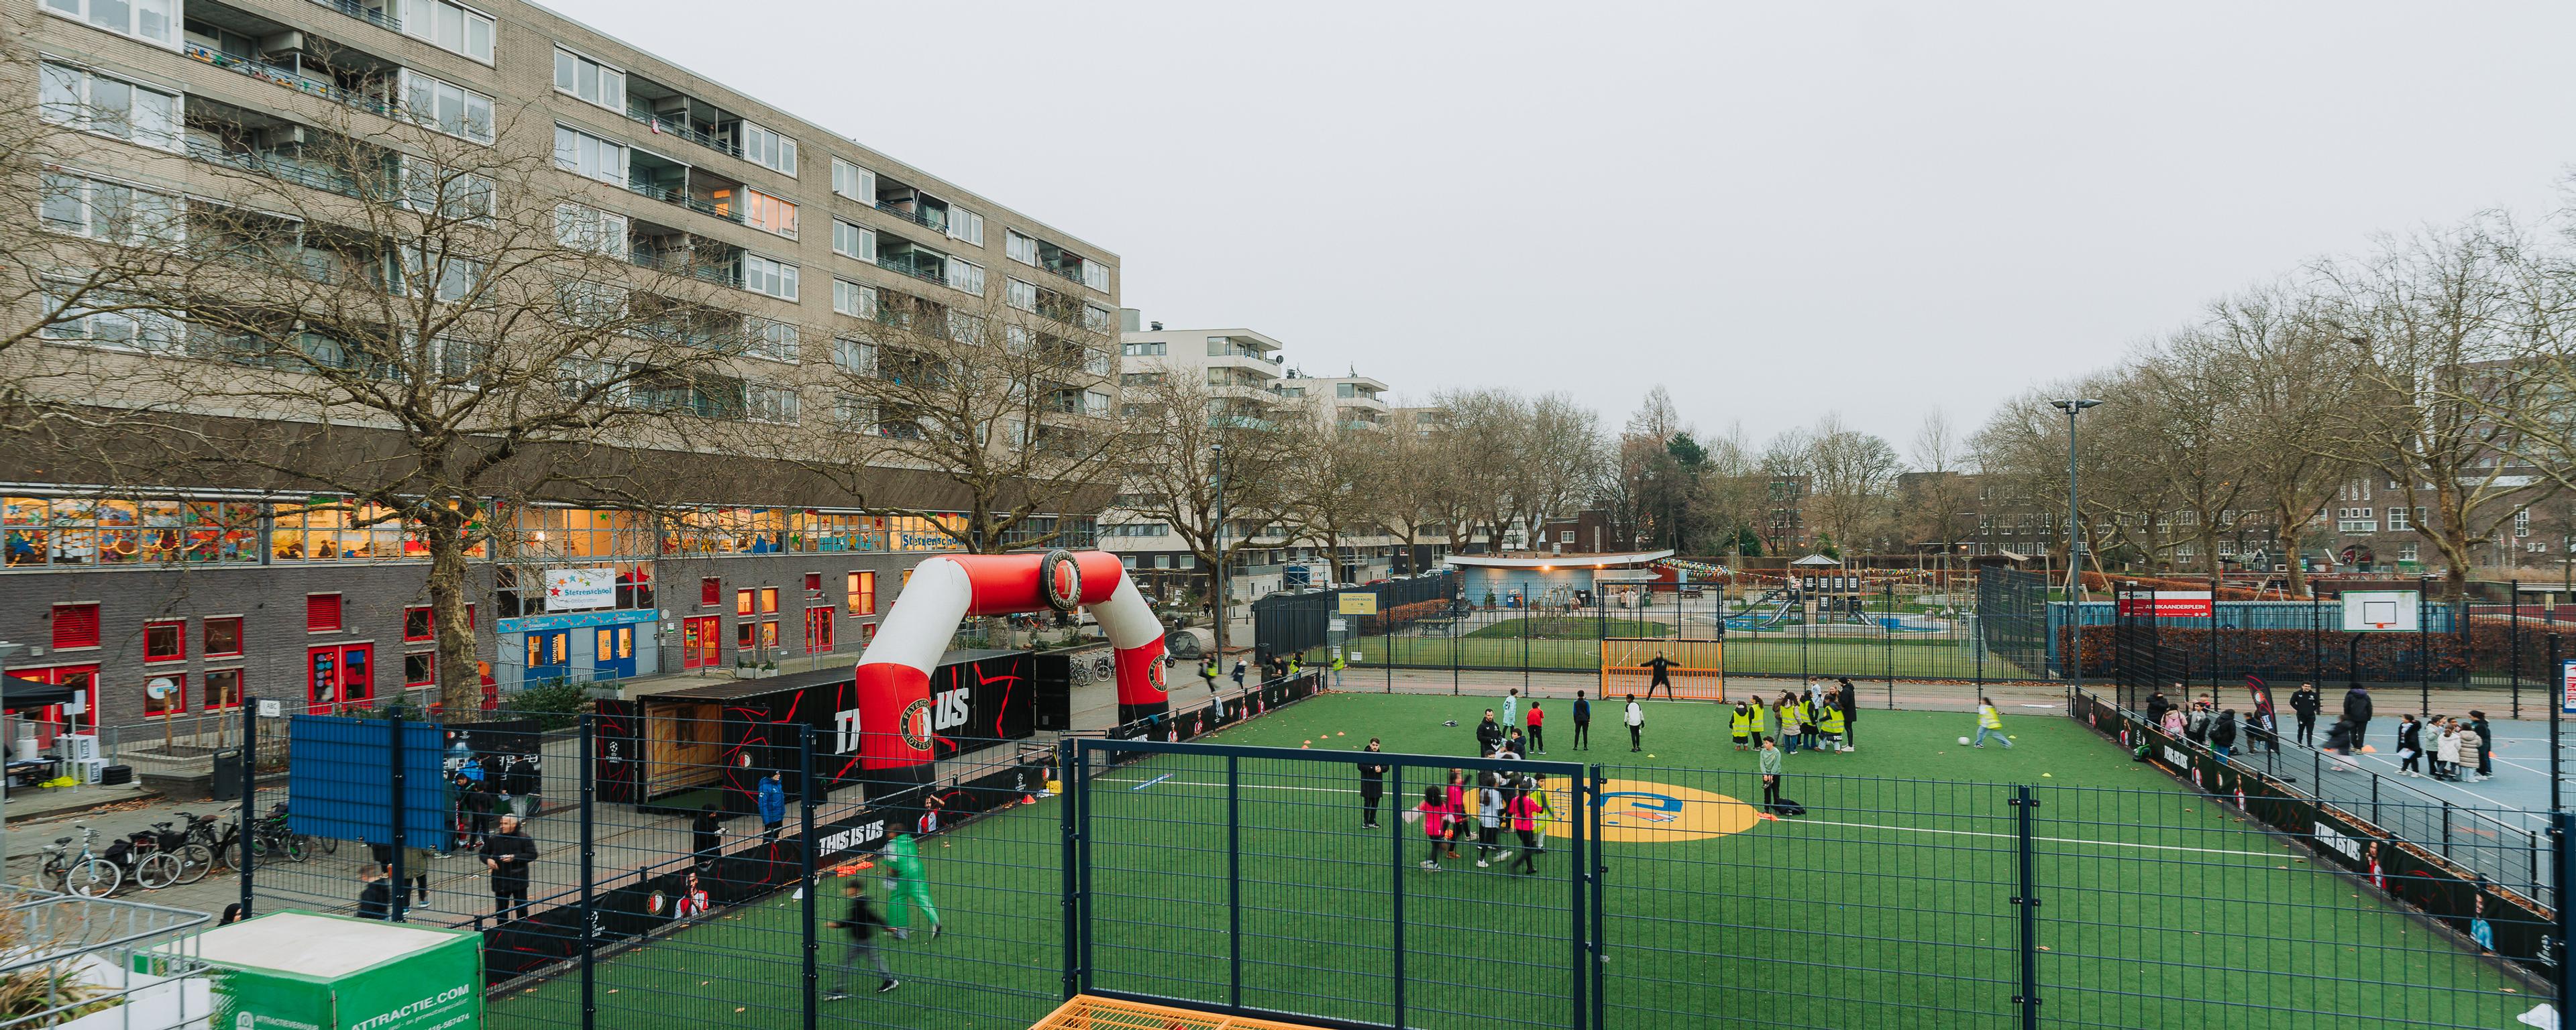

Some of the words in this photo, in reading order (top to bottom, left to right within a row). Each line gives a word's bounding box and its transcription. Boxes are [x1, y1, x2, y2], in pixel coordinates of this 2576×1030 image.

[903, 534, 965, 547] Sterrenscho
[1051, 552, 1081, 572] FEYENOORD
[565, 587, 612, 596] Sterrenschool
[1053, 587, 1081, 608] ROTTERDAM
[935, 687, 969, 731] US
[819, 830, 849, 857] THIS
[849, 825, 864, 847] IS
[865, 819, 883, 842] US
[2314, 821, 2335, 848] THIS
[2335, 832, 2347, 854] IS
[2347, 838, 2361, 862] US
[351, 984, 469, 1030] ATTRACTIE.COM
